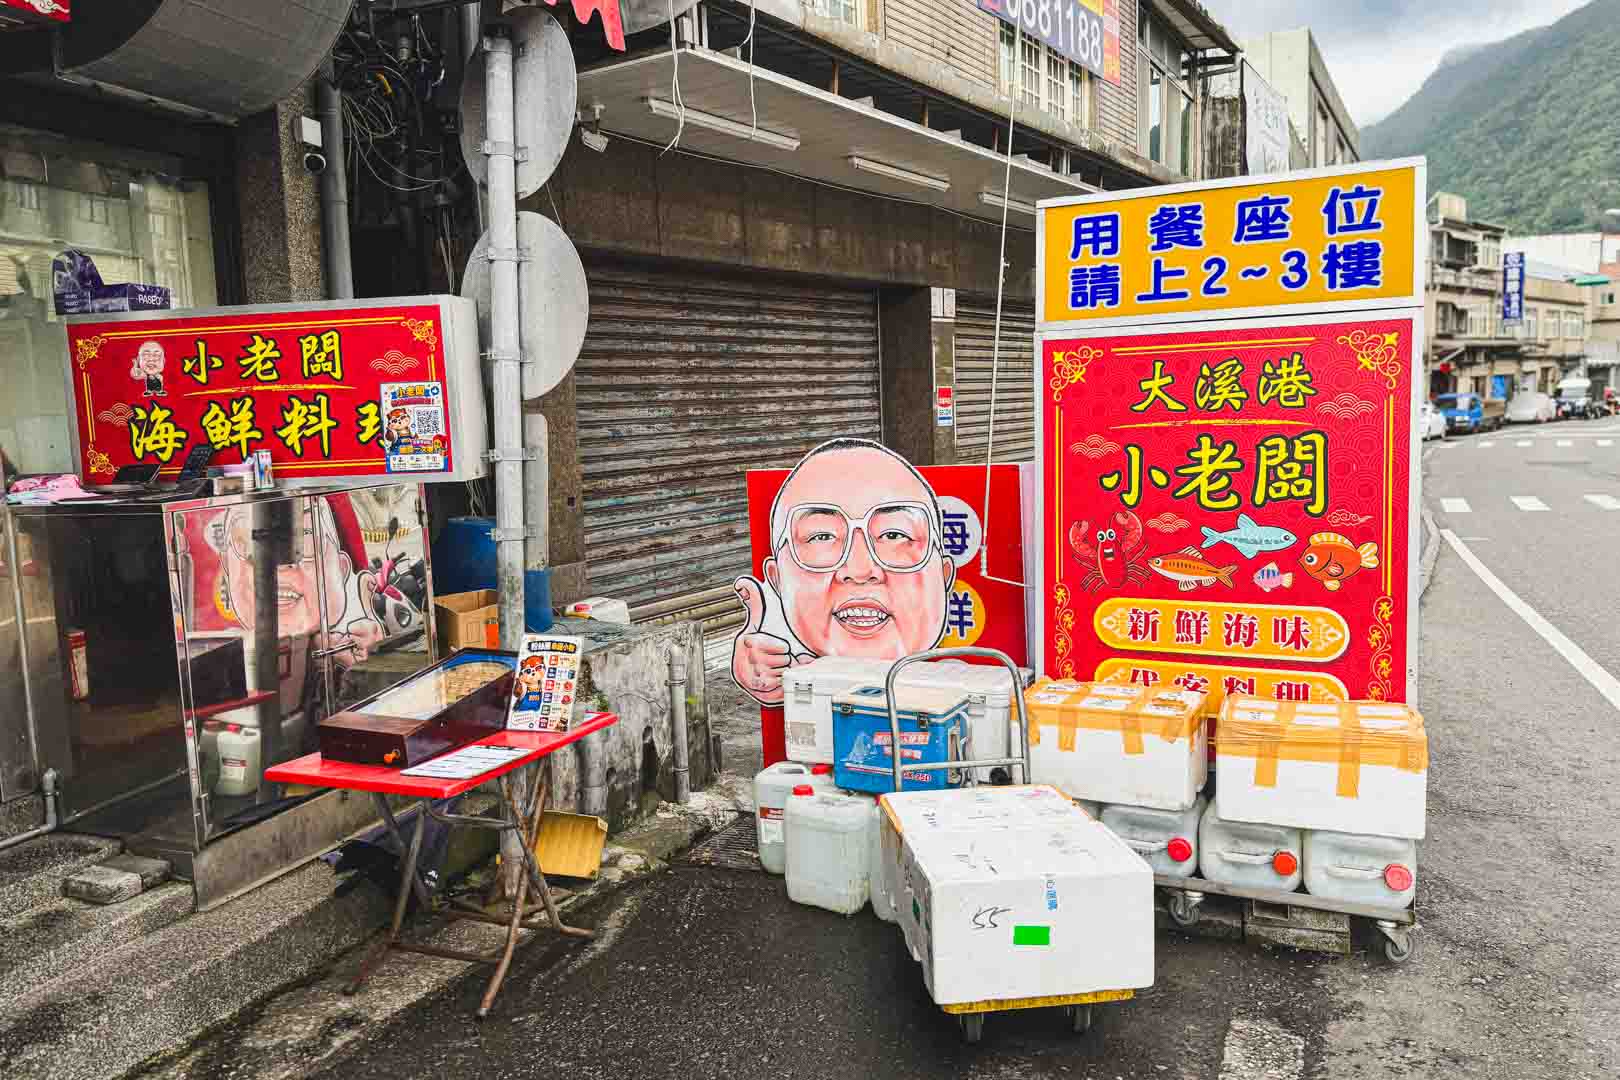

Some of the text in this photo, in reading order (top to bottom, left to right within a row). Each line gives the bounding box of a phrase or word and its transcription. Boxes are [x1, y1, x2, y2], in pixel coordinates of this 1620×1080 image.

[1070, 184, 1383, 260] 用餐座位
[181, 328, 345, 387] 小老闆
[1131, 352, 1317, 414] 大溪港
[1099, 429, 1330, 518] 小老闆
[1126, 606, 1312, 652] 新鮮海味
